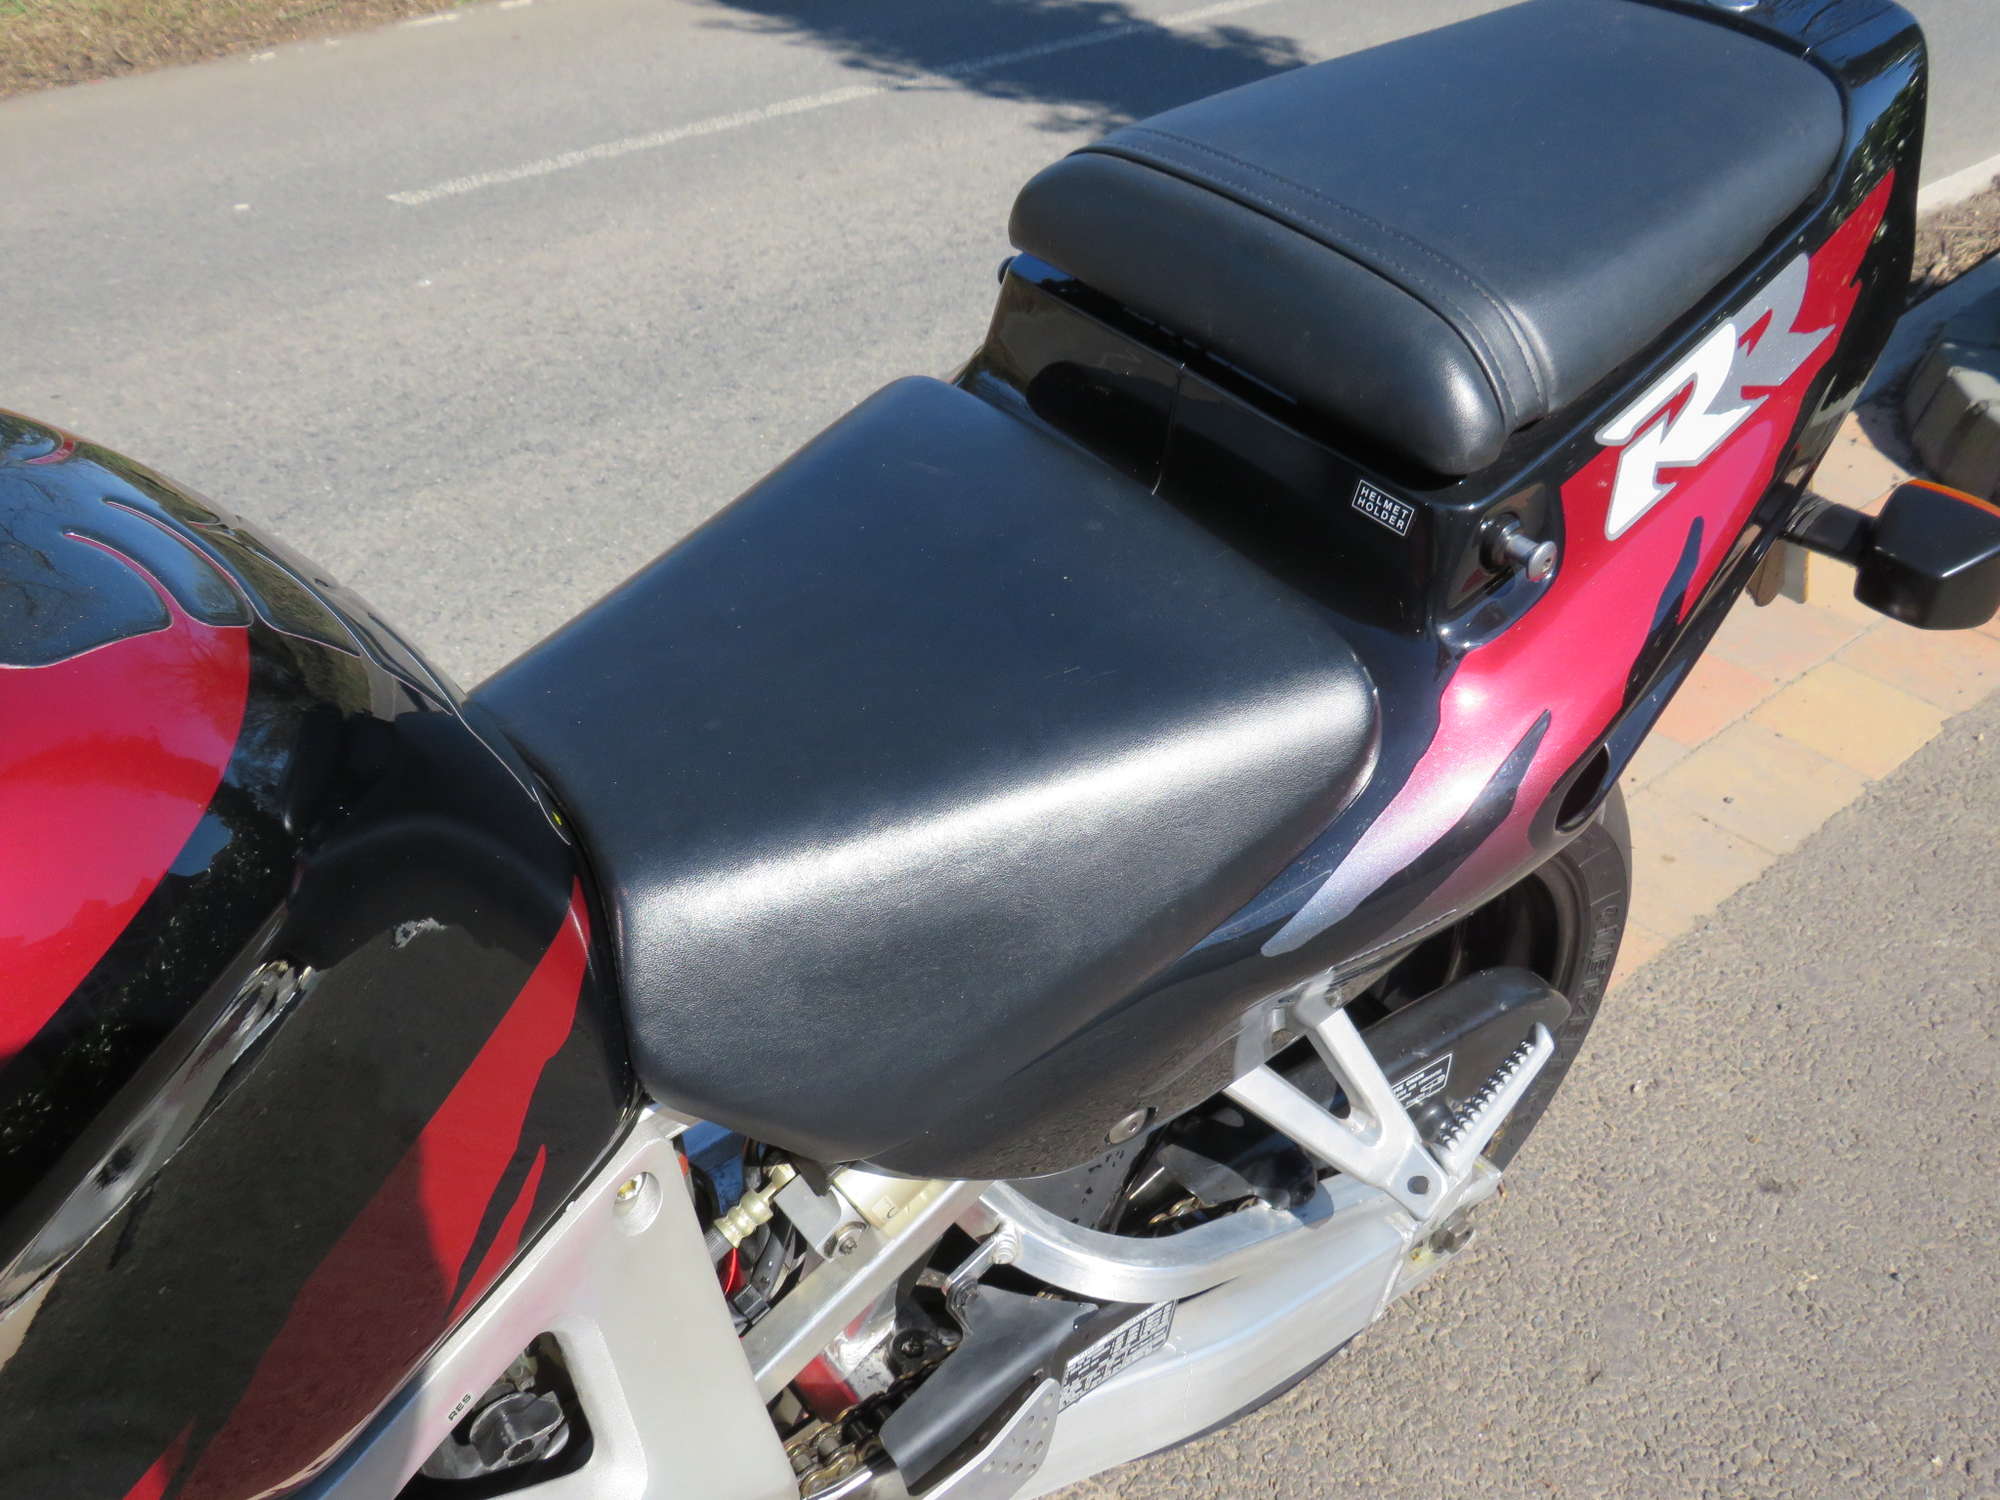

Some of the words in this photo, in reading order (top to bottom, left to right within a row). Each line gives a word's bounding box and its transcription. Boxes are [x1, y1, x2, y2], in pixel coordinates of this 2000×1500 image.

[1357, 496, 1405, 530] HOLDER
[1361, 486, 1409, 519] HELMET
[448, 1393, 471, 1420] RES
